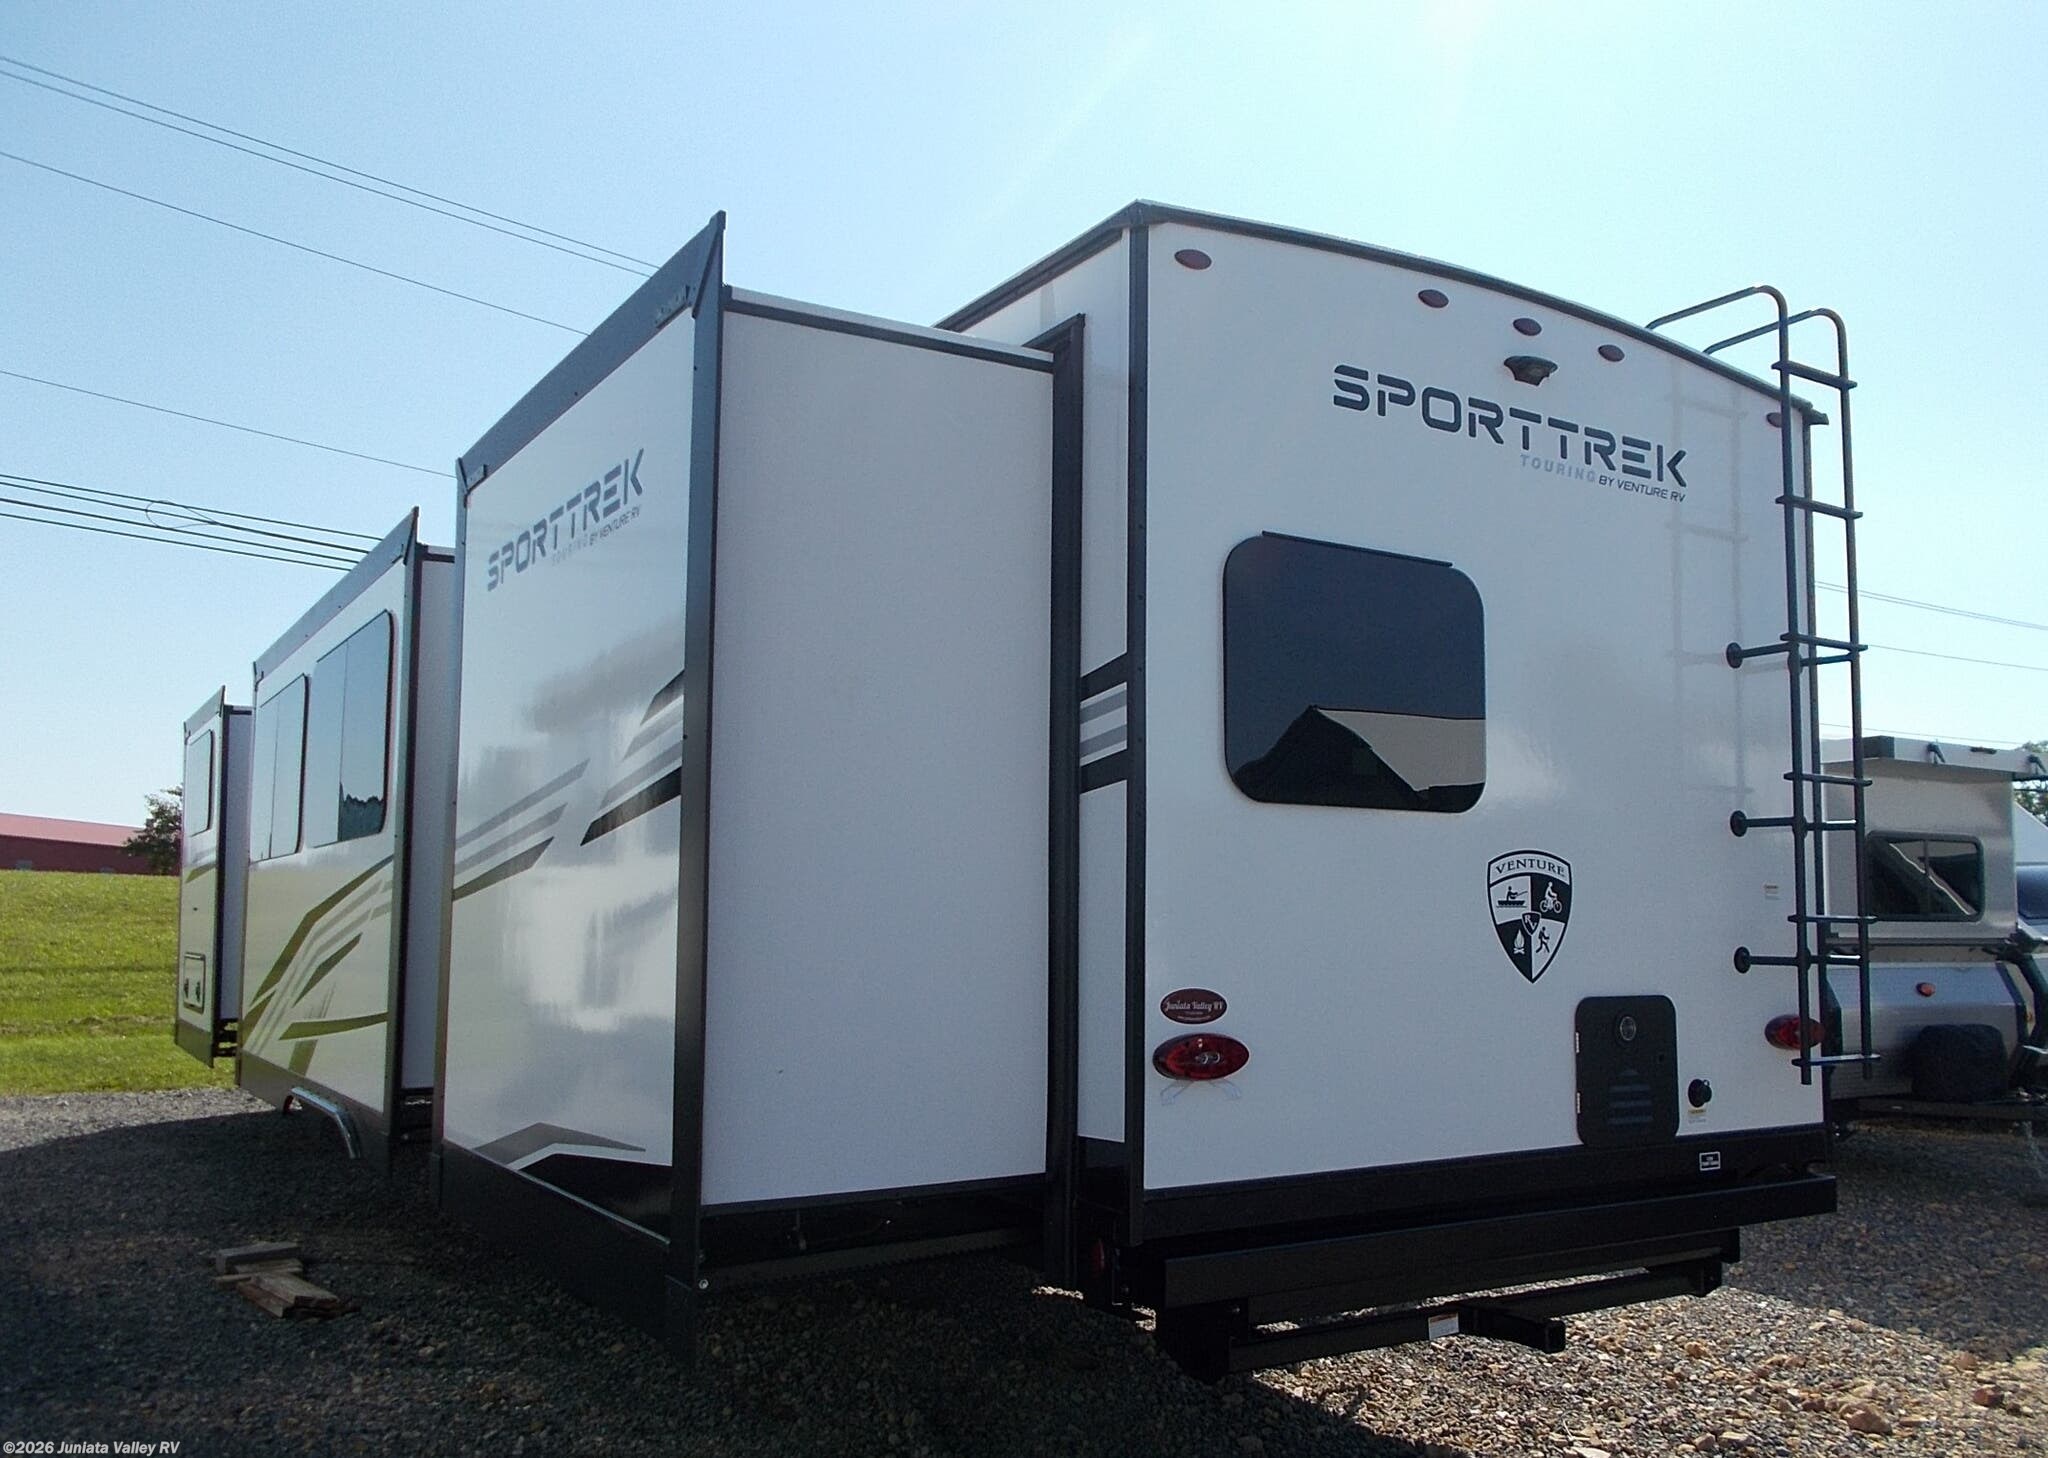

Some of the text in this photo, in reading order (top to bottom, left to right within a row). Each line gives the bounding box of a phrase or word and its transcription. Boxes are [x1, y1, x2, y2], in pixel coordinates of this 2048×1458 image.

[1333, 364, 1687, 487] SPORTTREK
[487, 448, 644, 591] SPORTTREK
[1520, 454, 1686, 502] TOURING BY VENTURE RV
[1495, 859, 1565, 878] VENTURE
